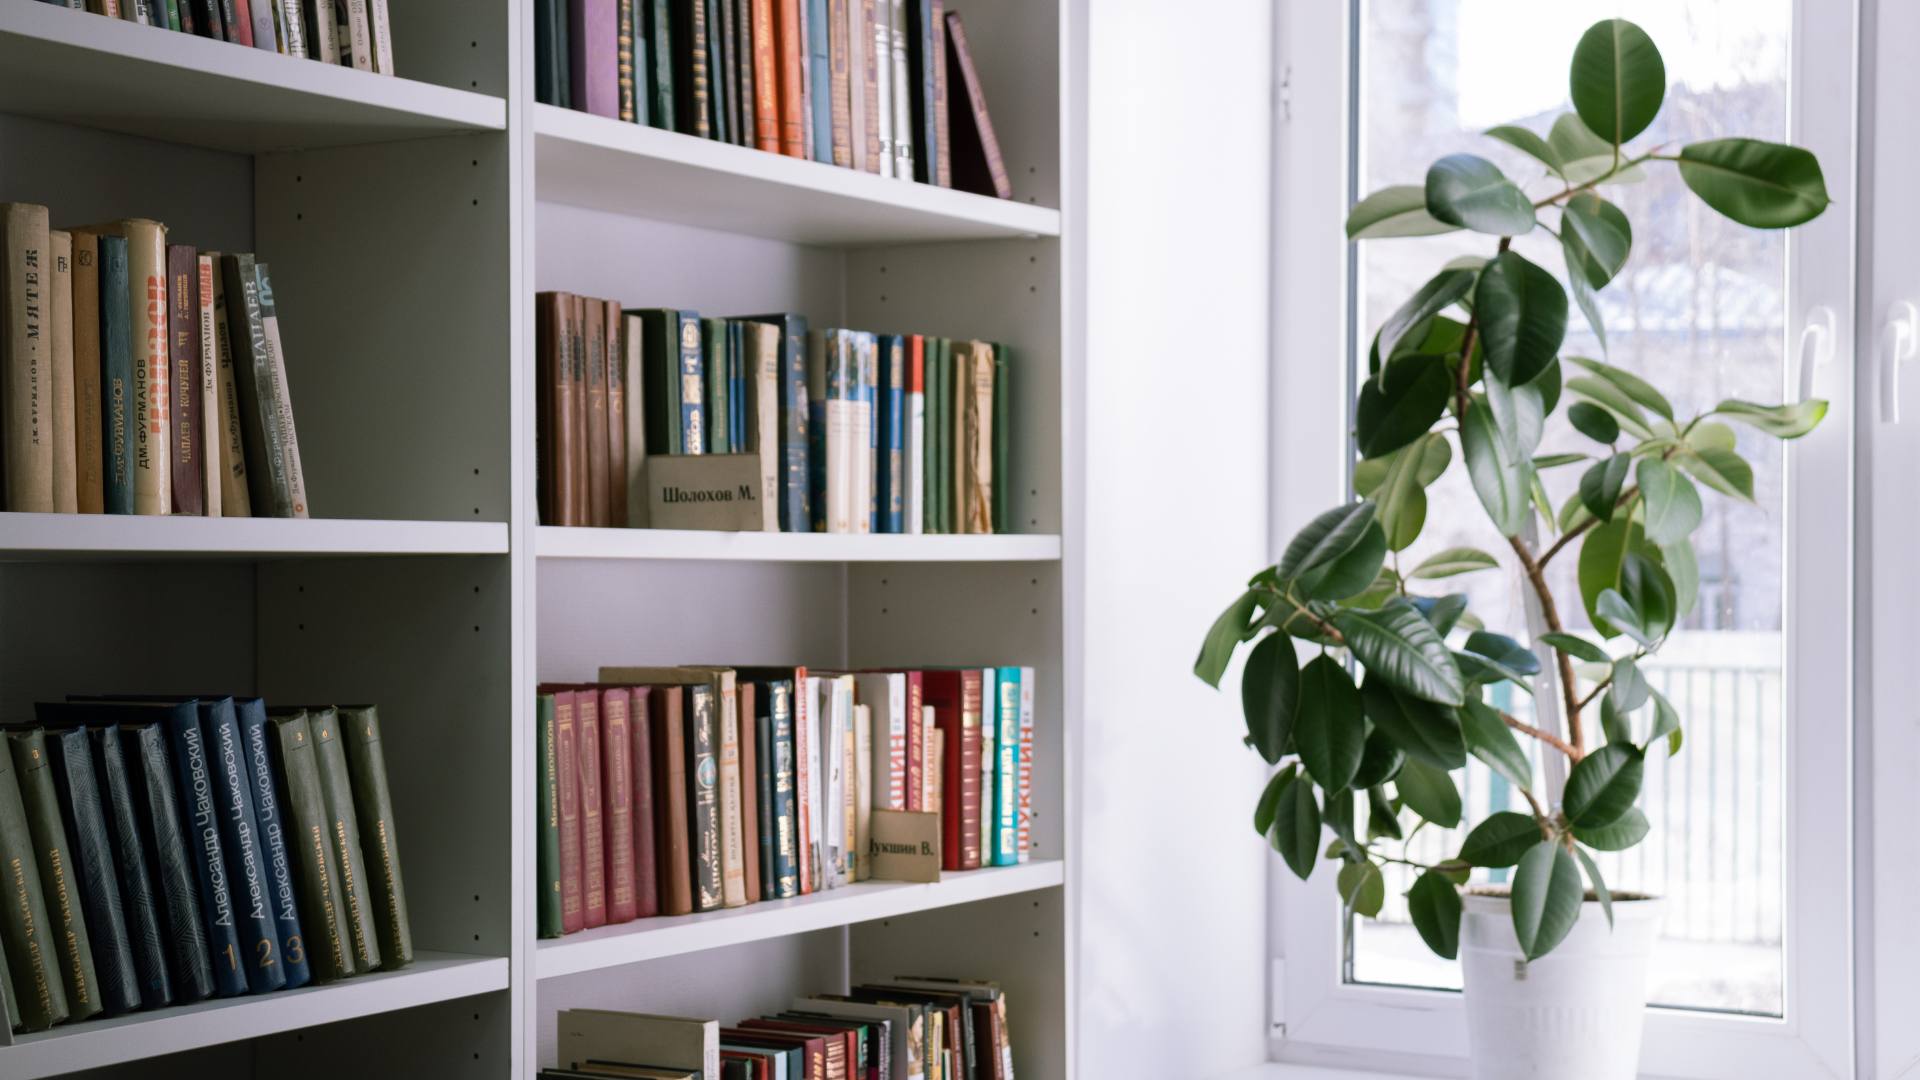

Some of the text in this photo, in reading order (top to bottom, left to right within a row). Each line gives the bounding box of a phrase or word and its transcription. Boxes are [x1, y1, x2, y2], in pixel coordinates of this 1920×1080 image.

[25, 248, 39, 340] МЯТЕЖ
[200, 263, 212, 308] ЧАПАЕВ
[202, 312, 212, 377] ФУРМАНОВ
[217, 321, 231, 369] Чапаев
[245, 280, 267, 368] ЧАПАЕВ
[177, 360, 191, 463] ЧАПАЕВ КОЧУБЕЙ
[662, 487, 733, 503] Шолохов
[737, 484, 756, 501] М.
[547, 720, 557, 781] ШОЛОХОВ
[889, 735, 904, 810] КШИН
[219, 722, 265, 920] Александр Чаковский
[249, 723, 295, 921] Александр Чаковский
[1018, 727, 1031, 851] ШУКШИН
[184, 727, 231, 927] Александр Чаковский
[311, 825, 330, 897] ЧАКОВСКИЙ
[336, 820, 354, 892] ЧАКОВСКИЙ
[869, 838, 935, 856] укшин В.
[49, 847, 73, 926] ЧАКОВСКИЙ
[222, 944, 236, 972] 1
[256, 938, 275, 967] 2
[286, 935, 304, 964] 3
